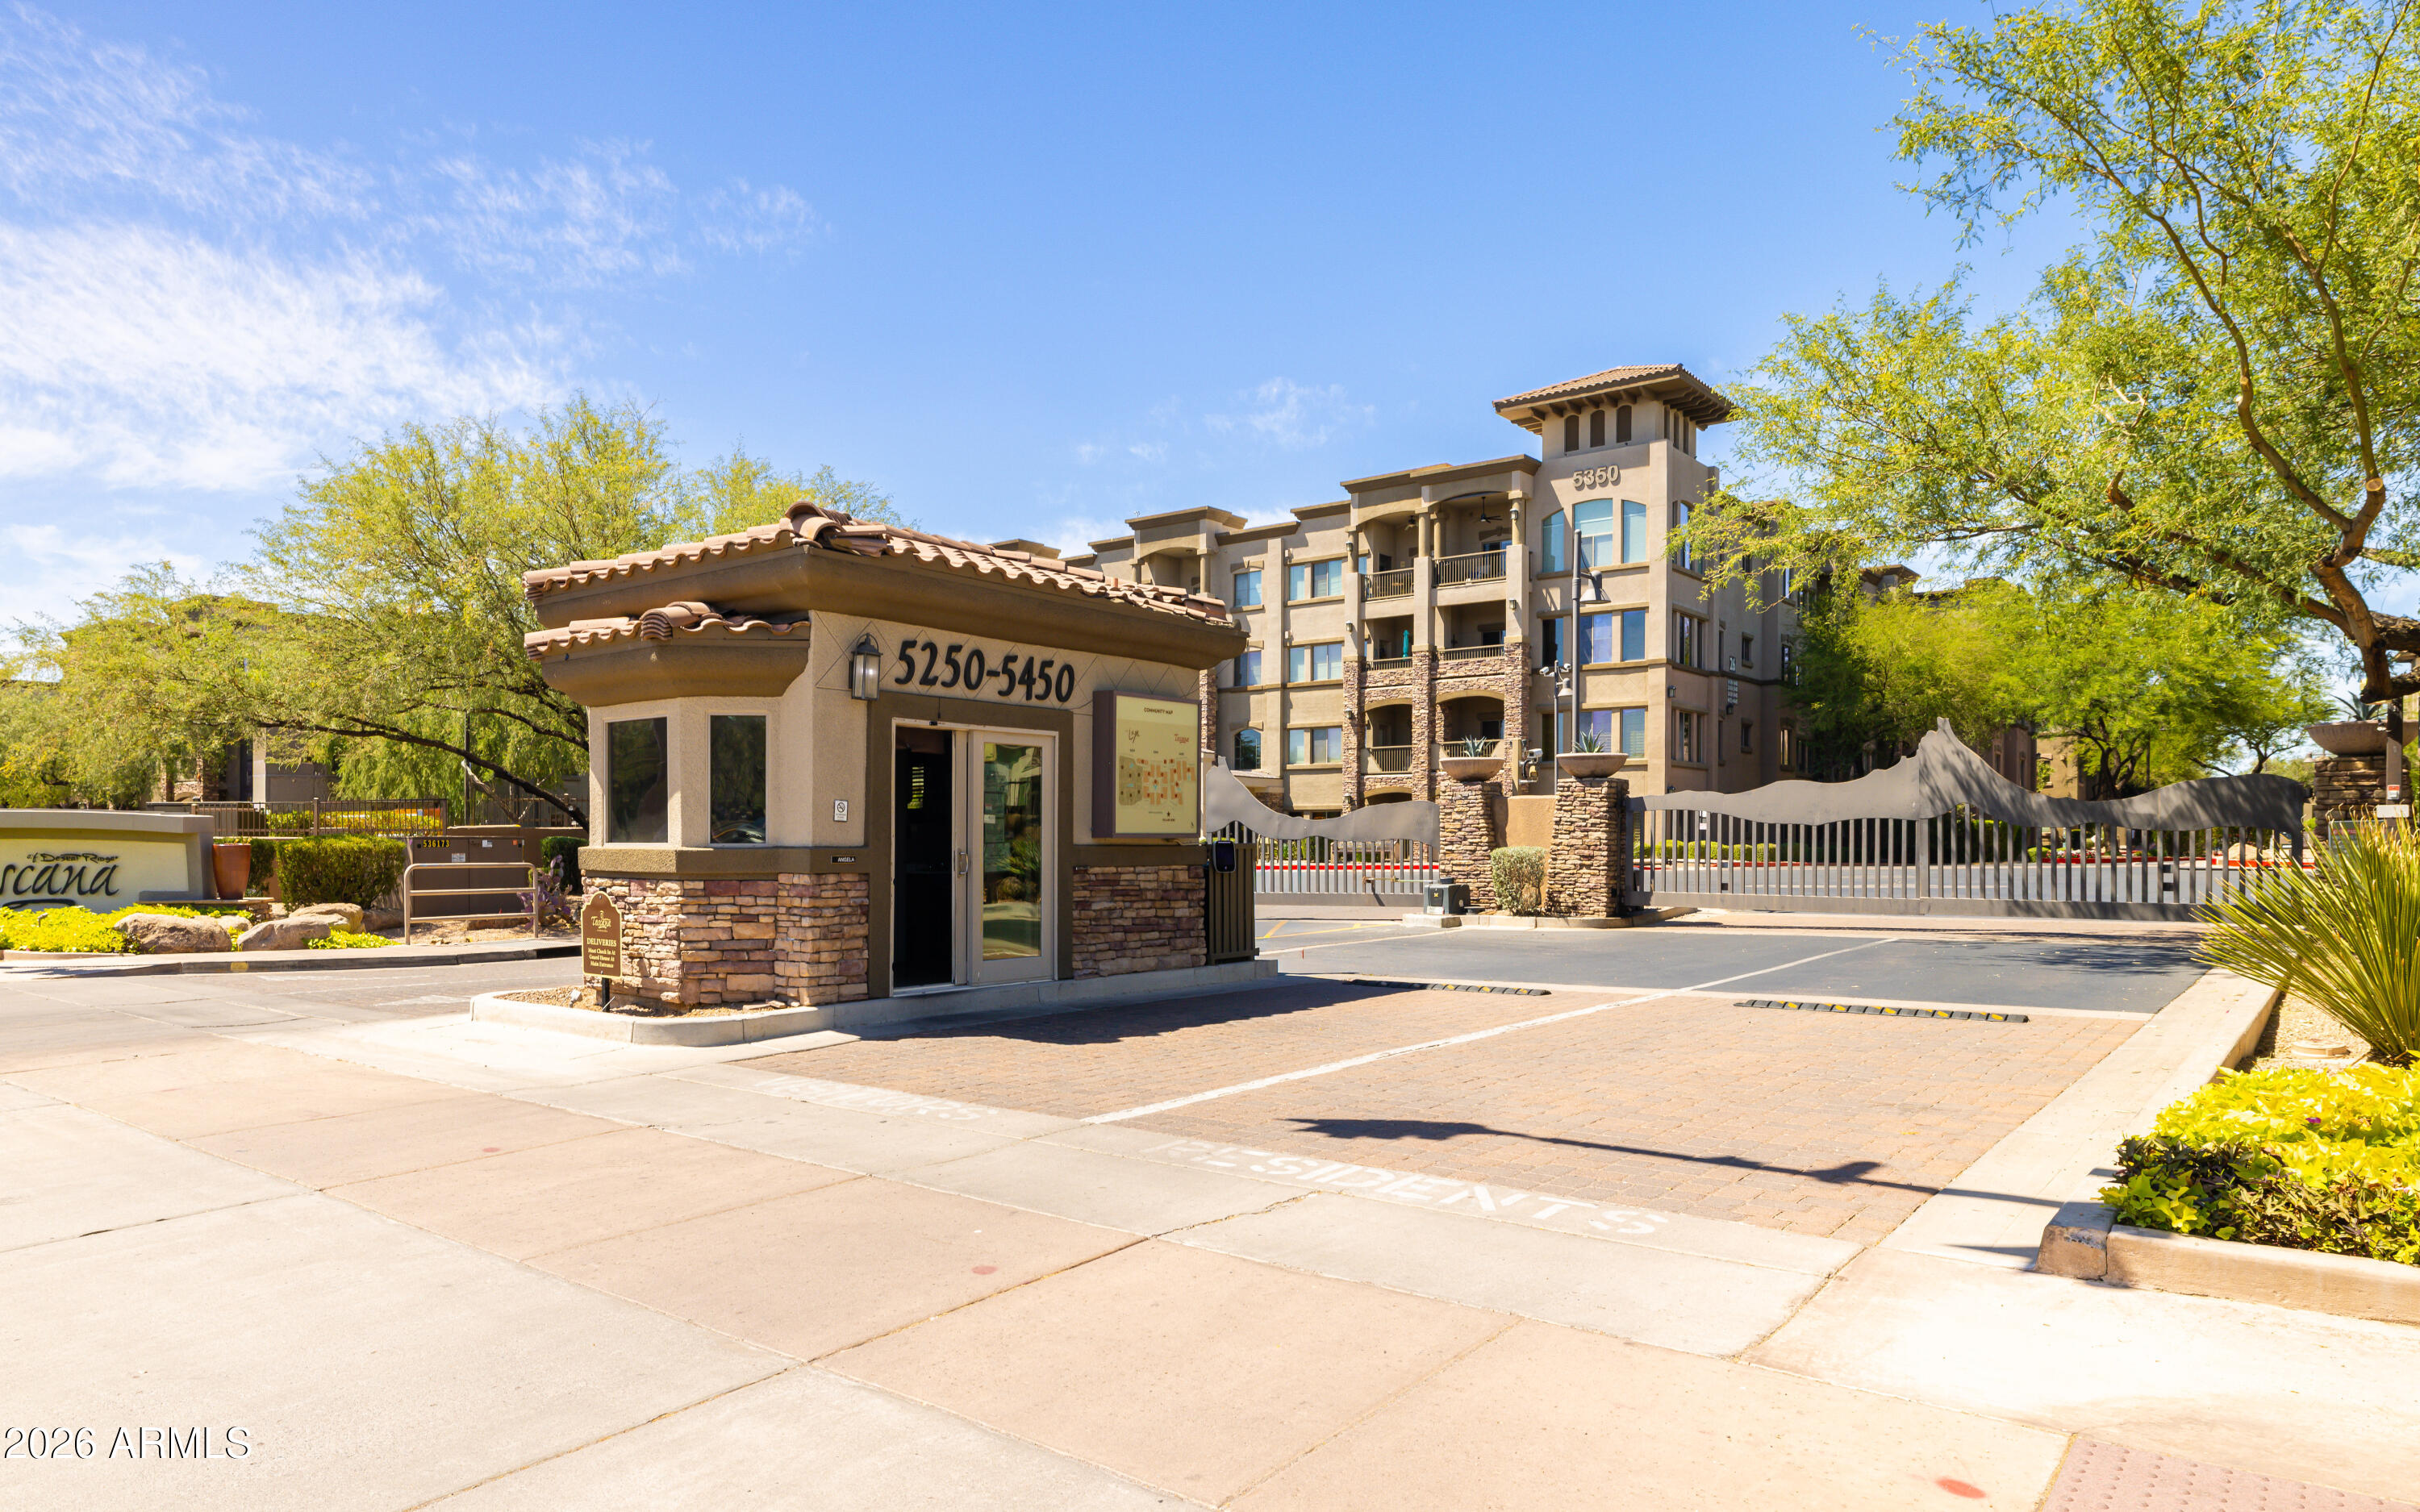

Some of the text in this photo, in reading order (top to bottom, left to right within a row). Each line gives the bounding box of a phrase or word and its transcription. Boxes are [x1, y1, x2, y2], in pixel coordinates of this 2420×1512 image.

[1572, 464, 1619, 488] 5350
[895, 639, 1075, 703] 5250-5450
[1729, 657, 1736, 672] 26
[423, 839, 450, 848] 536173
[586, 938, 616, 947] DELIVERIES
[1139, 1139, 1668, 1235] RESIDENTS
